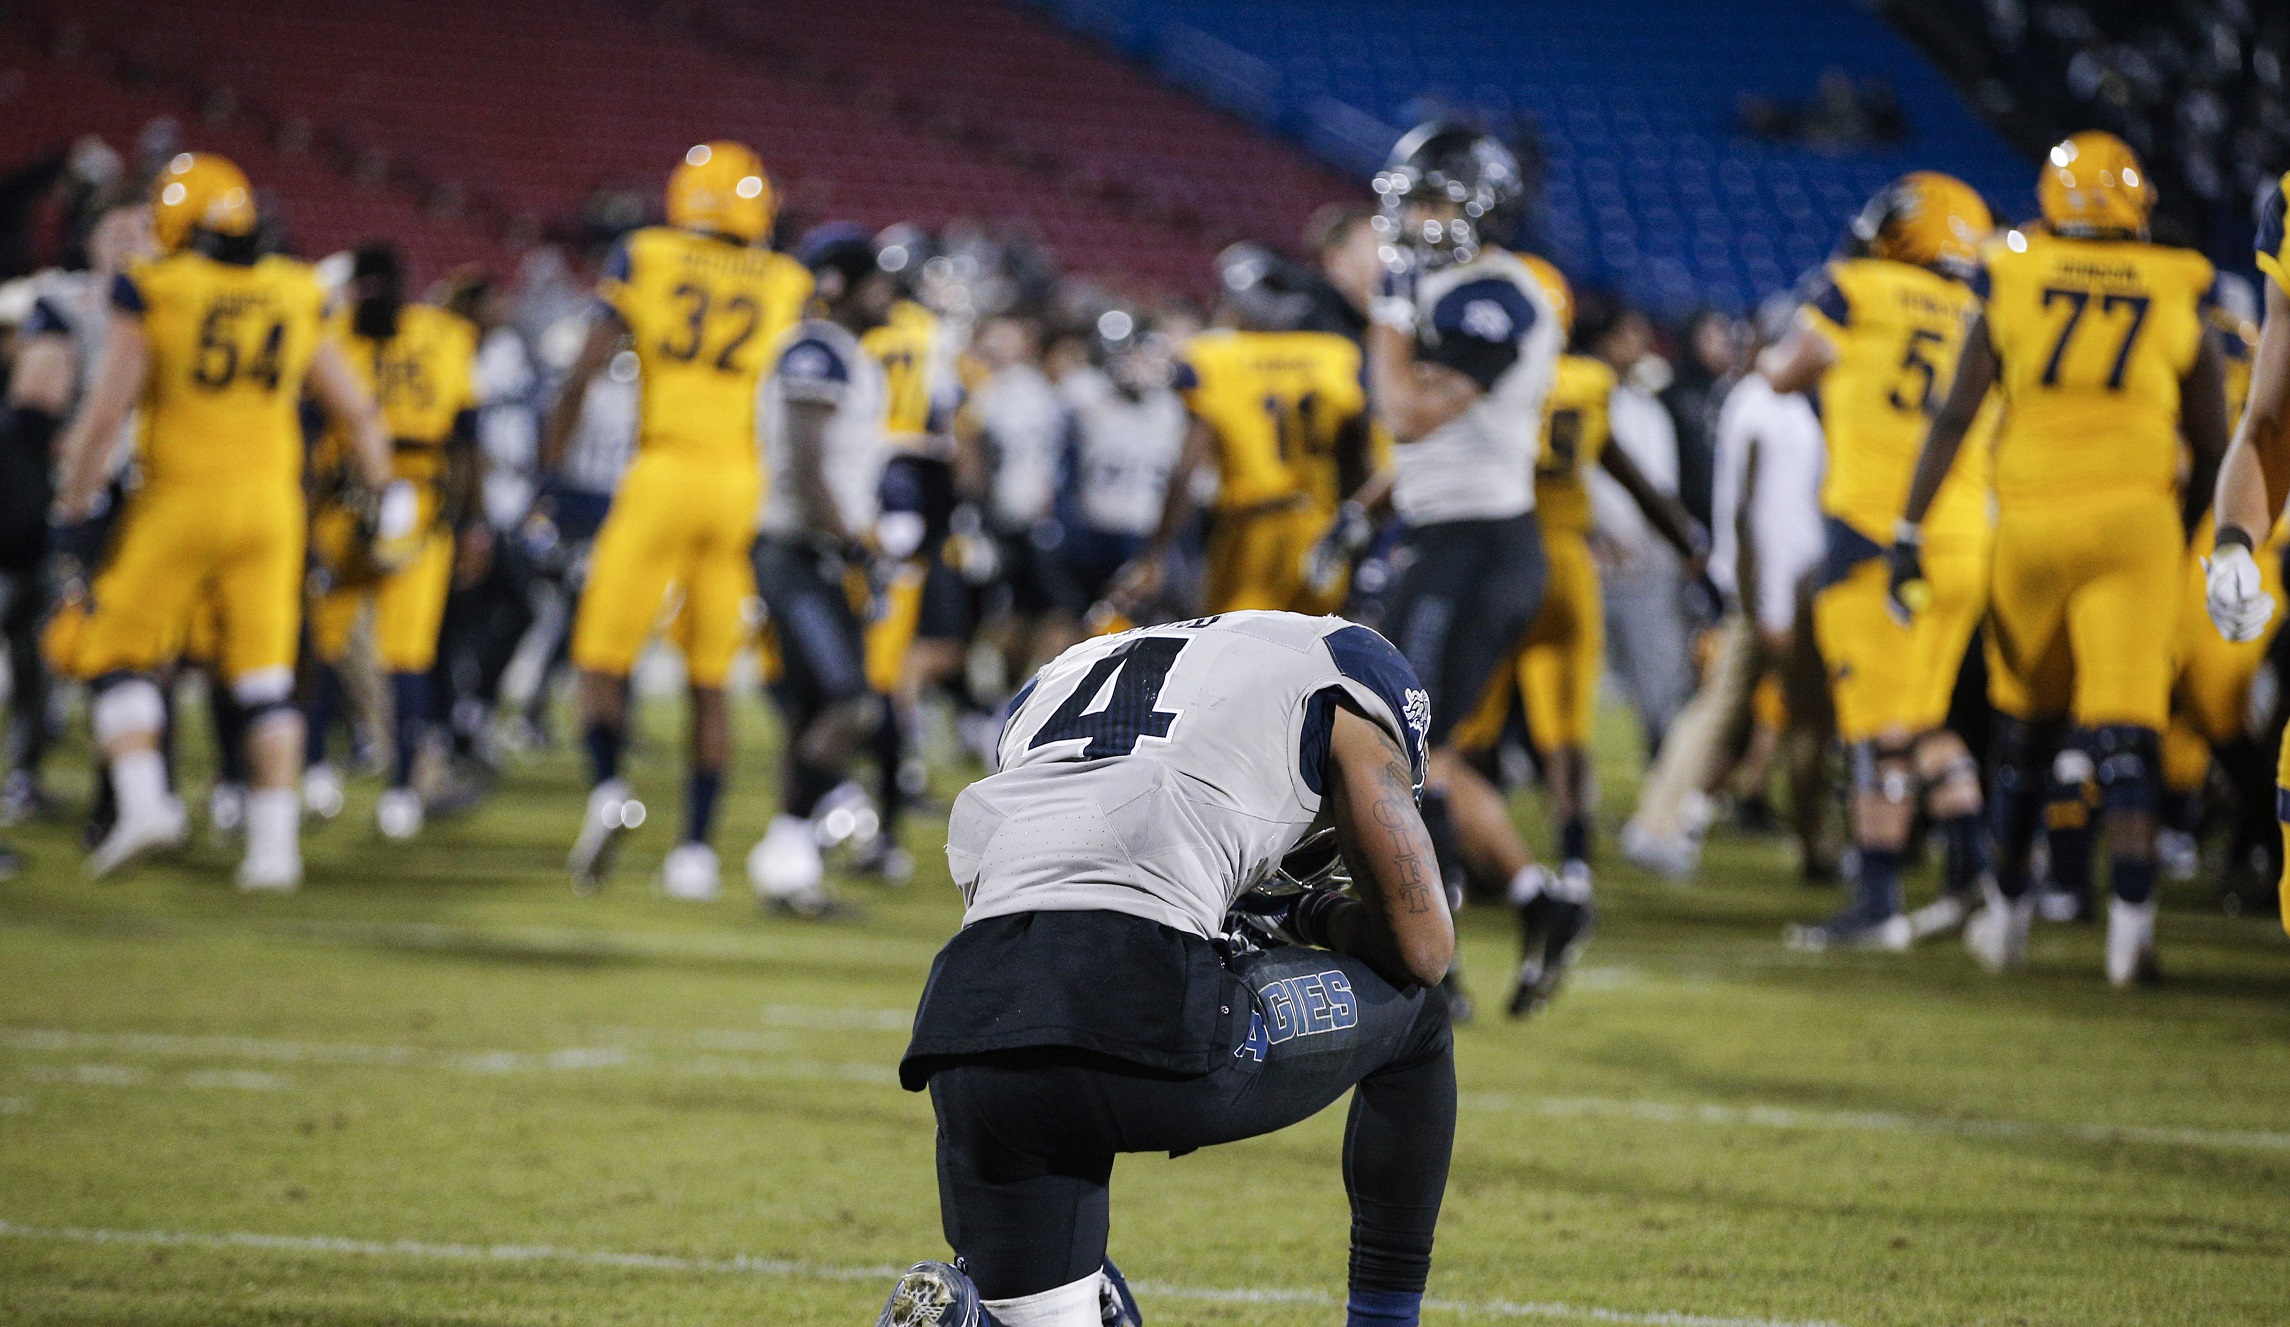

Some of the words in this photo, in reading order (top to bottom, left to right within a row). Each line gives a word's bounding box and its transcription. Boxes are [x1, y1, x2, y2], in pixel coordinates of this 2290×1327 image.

[194, 307, 285, 391] 54
[659, 283, 761, 374] 32
[1887, 328, 1944, 412] 5
[2041, 287, 2150, 388] 77
[1023, 634, 1197, 758] 4
[1234, 969, 1359, 1063] AGIES
